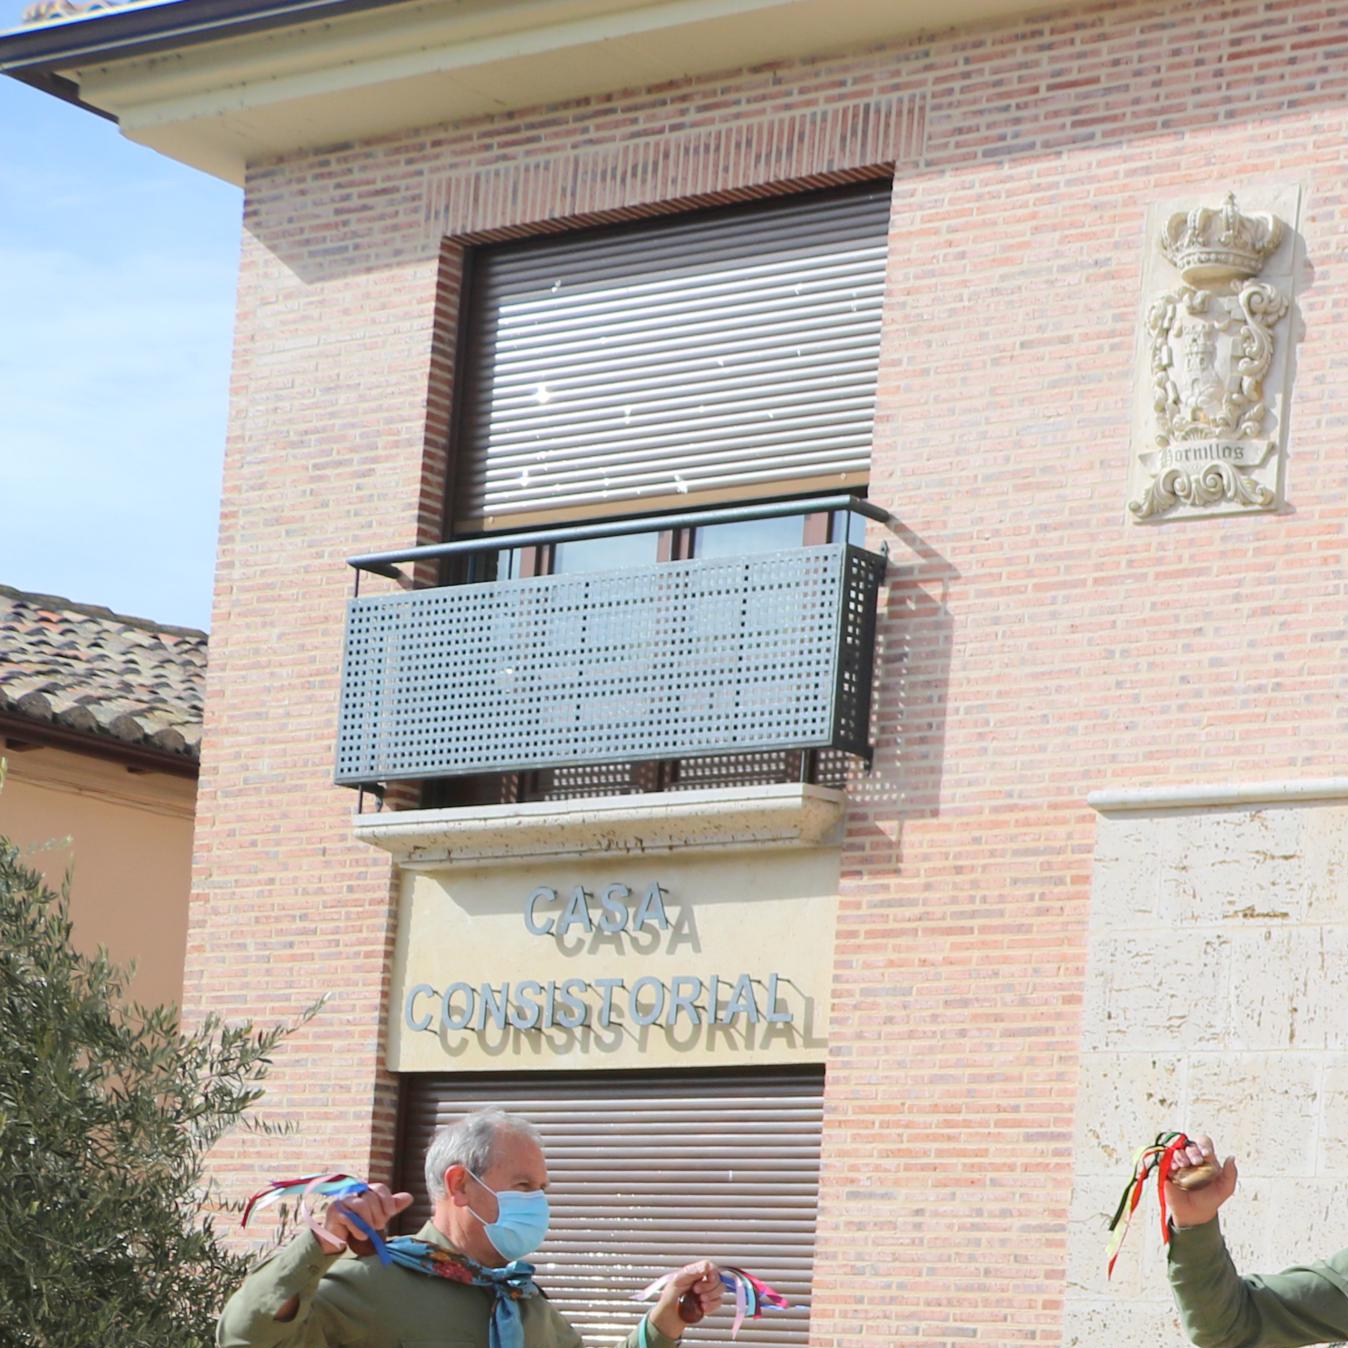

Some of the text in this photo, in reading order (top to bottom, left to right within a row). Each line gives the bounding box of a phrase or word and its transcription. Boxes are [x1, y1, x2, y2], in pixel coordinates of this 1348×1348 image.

[1160, 444, 1244, 467] Hornillos
[523, 880, 669, 935] CASA
[405, 972, 794, 1031] CONSISTORIAL
